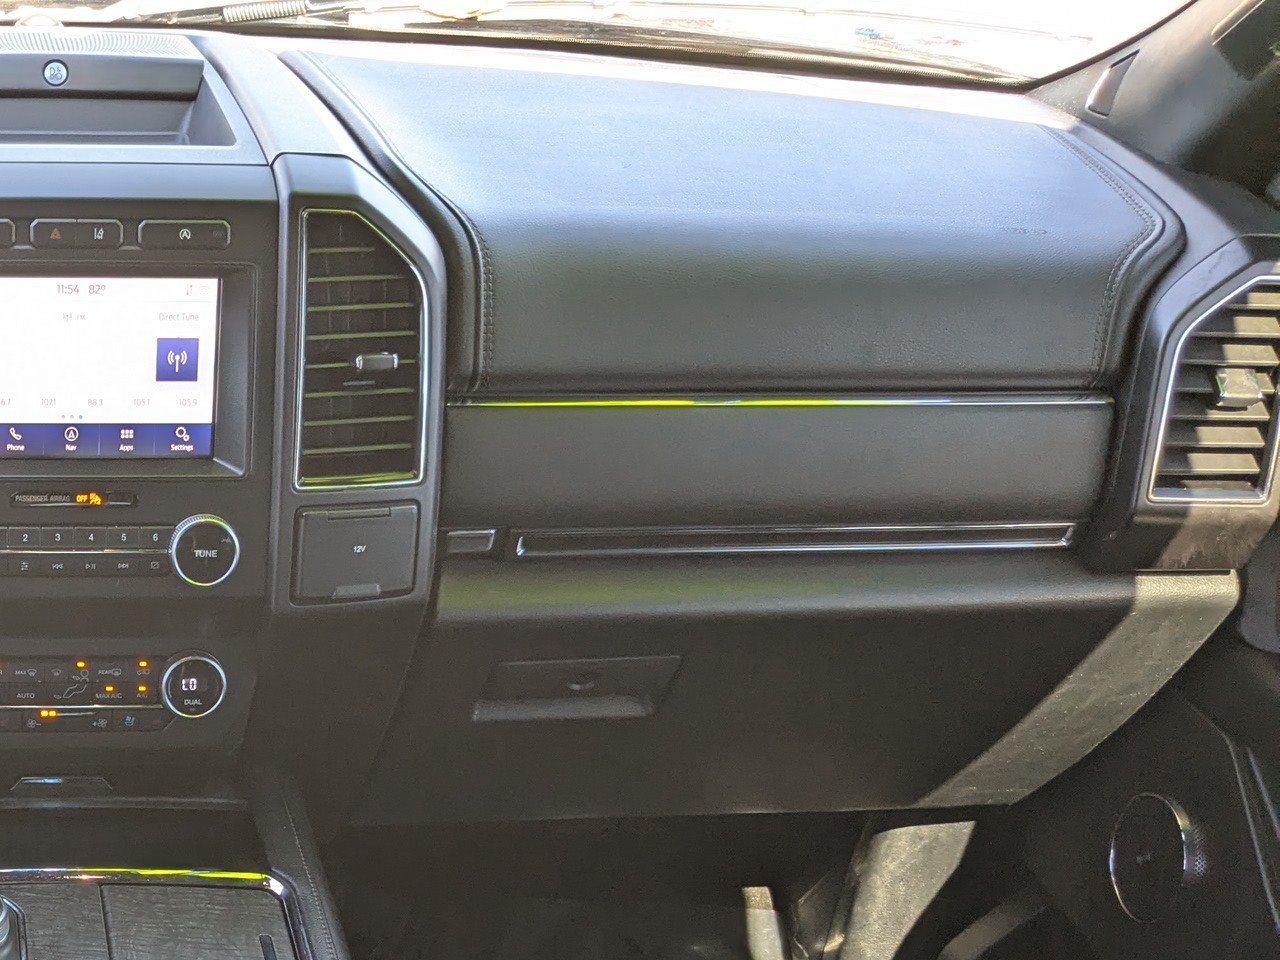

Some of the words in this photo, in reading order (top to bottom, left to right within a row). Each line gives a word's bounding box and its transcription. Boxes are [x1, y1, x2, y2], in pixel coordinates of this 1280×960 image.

[56, 284, 80, 295] 11:54
[158, 312, 179, 321] Direct
[6, 443, 25, 451] Phone
[119, 444, 134, 452] Apps
[170, 443, 194, 452] Settings
[76, 494, 88, 502] OFF
[22, 533, 29, 542] 2
[54, 533, 61, 542] 3
[88, 533, 95, 541] 4
[121, 533, 127, 541] 5
[152, 533, 159, 541] 6
[194, 549, 218, 558] TUNE
[182, 677, 197, 691] LO
[184, 698, 202, 706] DUAL
